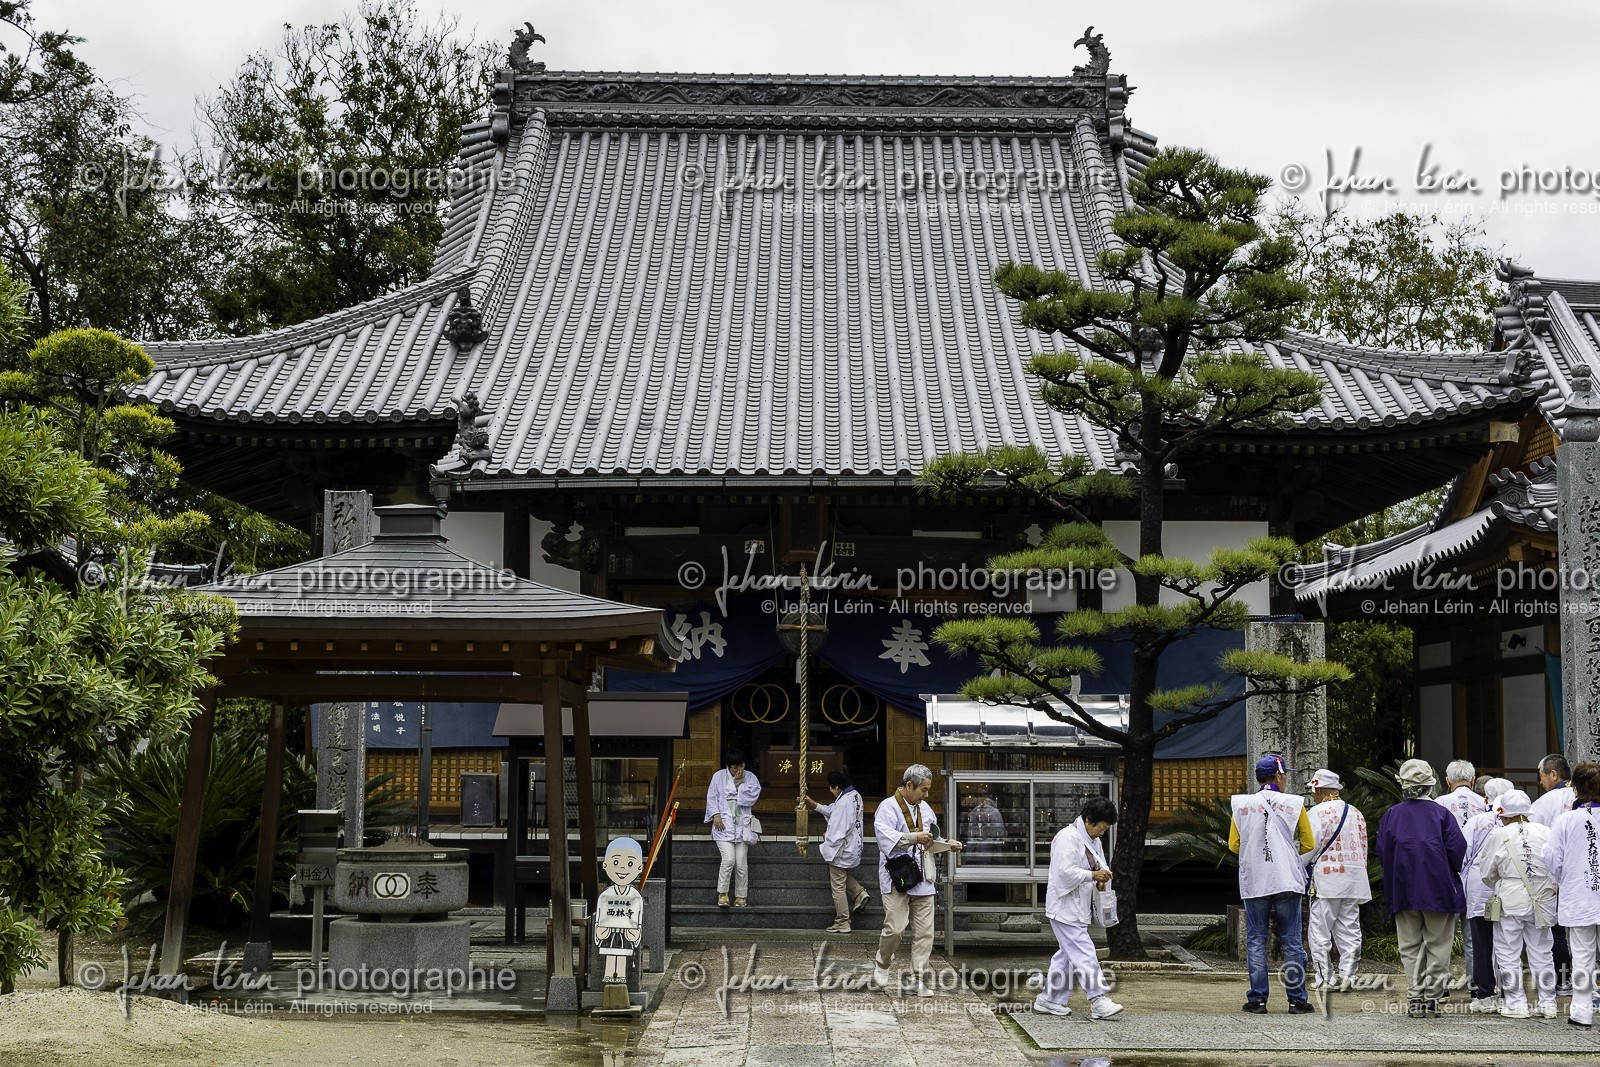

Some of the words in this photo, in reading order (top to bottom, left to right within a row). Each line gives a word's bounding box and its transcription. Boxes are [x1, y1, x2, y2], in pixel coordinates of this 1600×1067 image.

[878, 619, 931, 674] 奉
[606, 908, 634, 919] 西林寺
